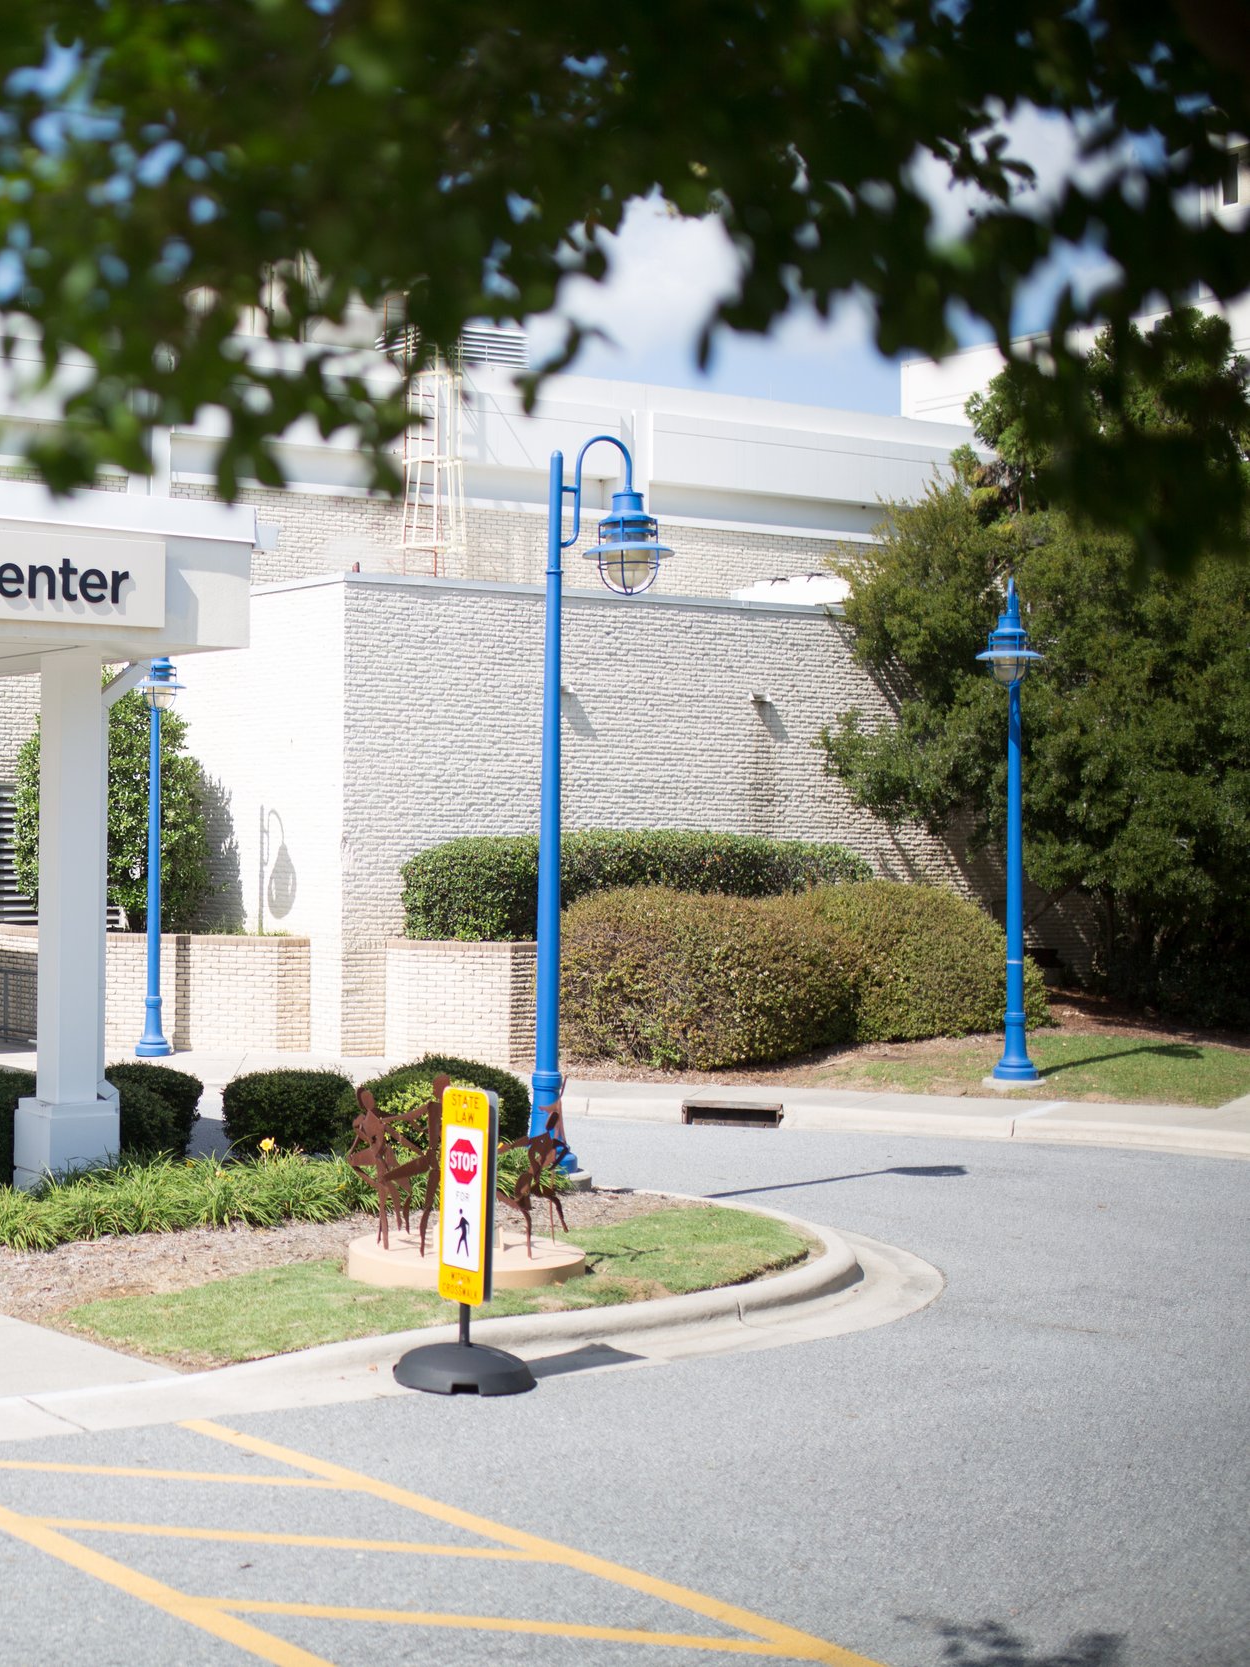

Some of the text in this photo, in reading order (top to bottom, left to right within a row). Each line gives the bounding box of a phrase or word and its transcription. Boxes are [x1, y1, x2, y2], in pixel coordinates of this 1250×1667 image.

[451, 1093, 480, 1110] STATE
[455, 1110, 475, 1124] LAW
[450, 1150, 478, 1173] STOP
[455, 1190, 470, 1202] FOR
